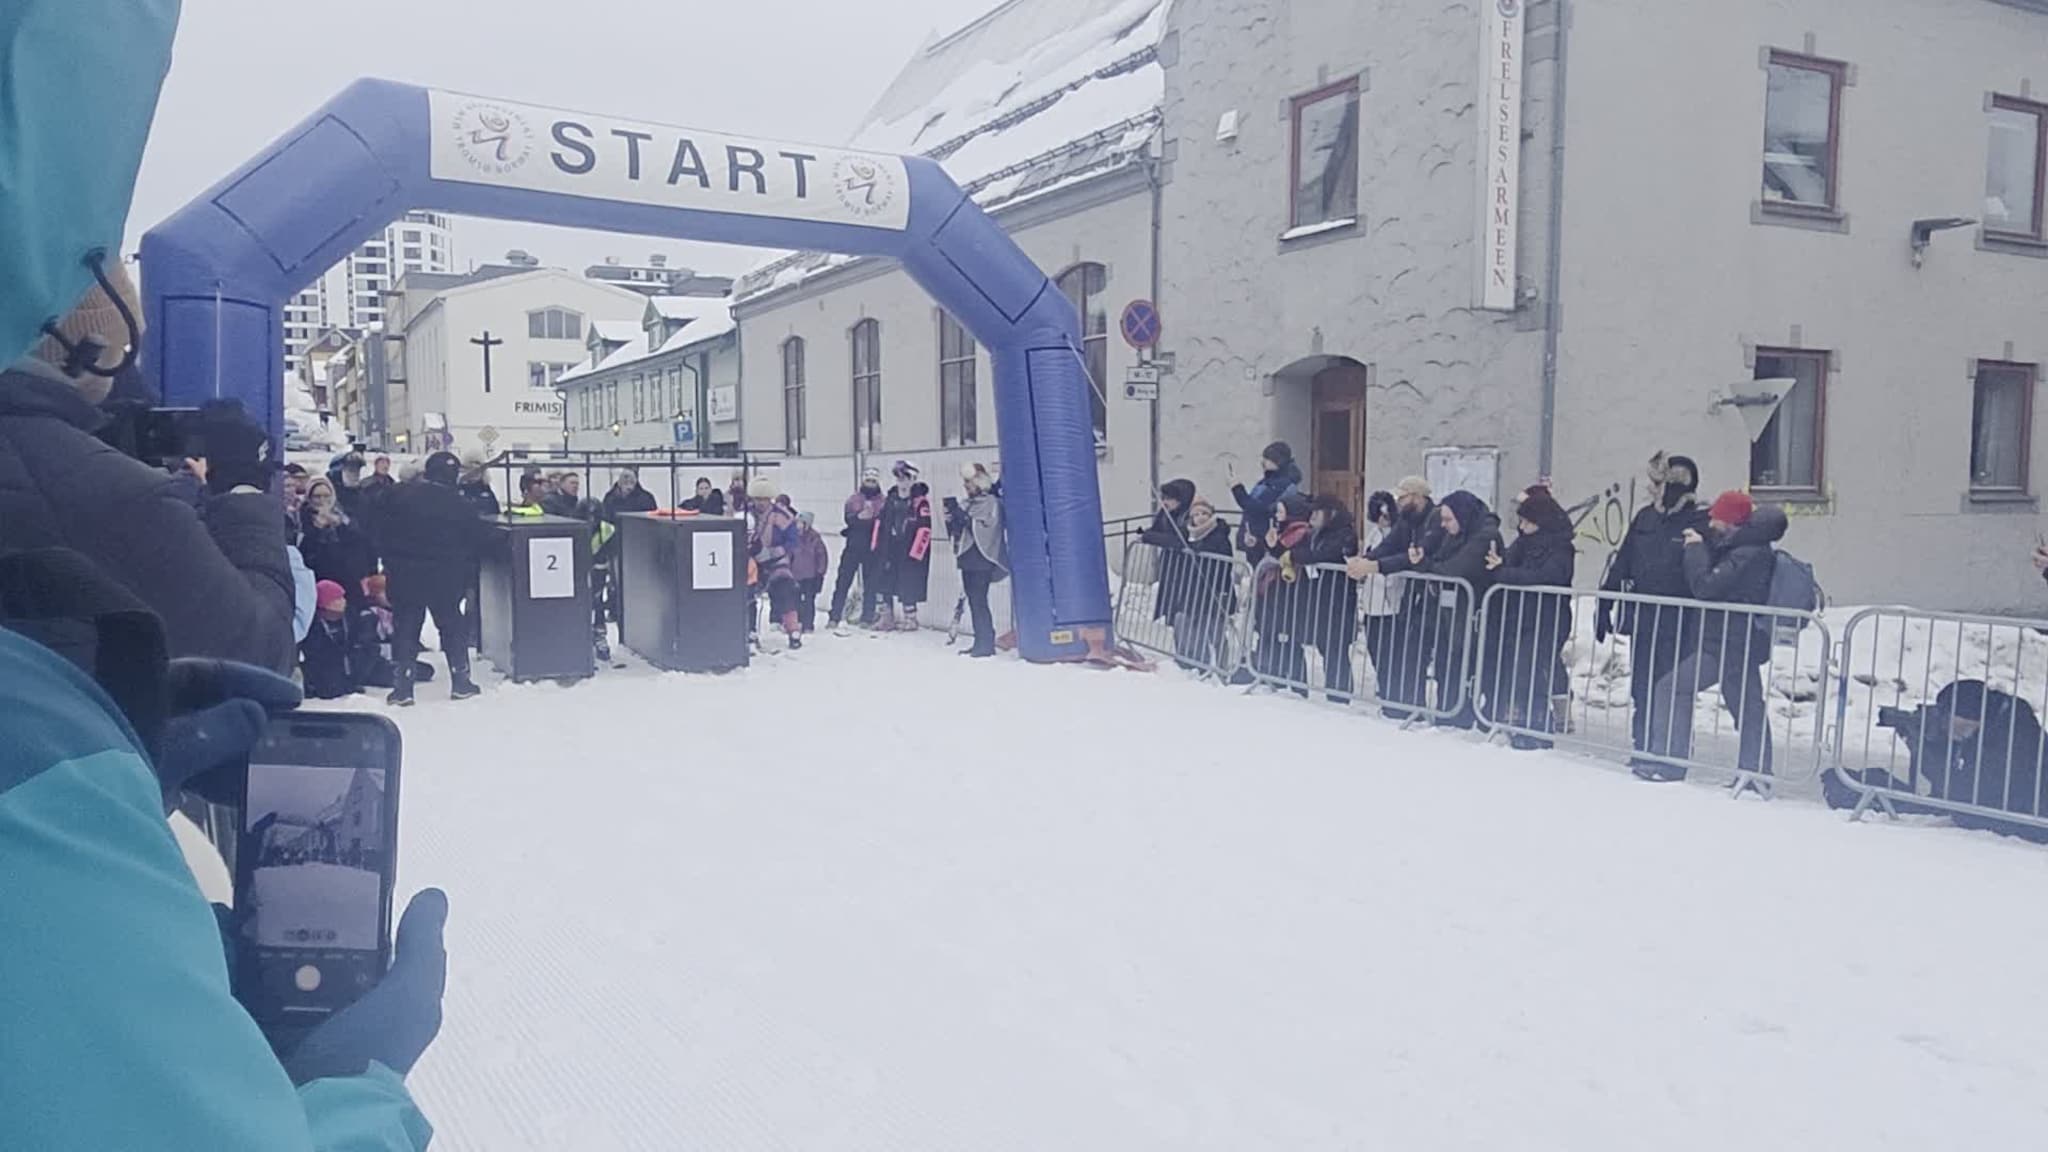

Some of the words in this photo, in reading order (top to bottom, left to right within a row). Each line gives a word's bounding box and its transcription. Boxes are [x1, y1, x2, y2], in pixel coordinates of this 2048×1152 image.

[550, 120, 817, 199] START
[1493, 20, 1512, 288] FRELSESARMEEN
[677, 424, 689, 440] P
[546, 554, 558, 570] 2
[708, 551, 718, 567] 1
